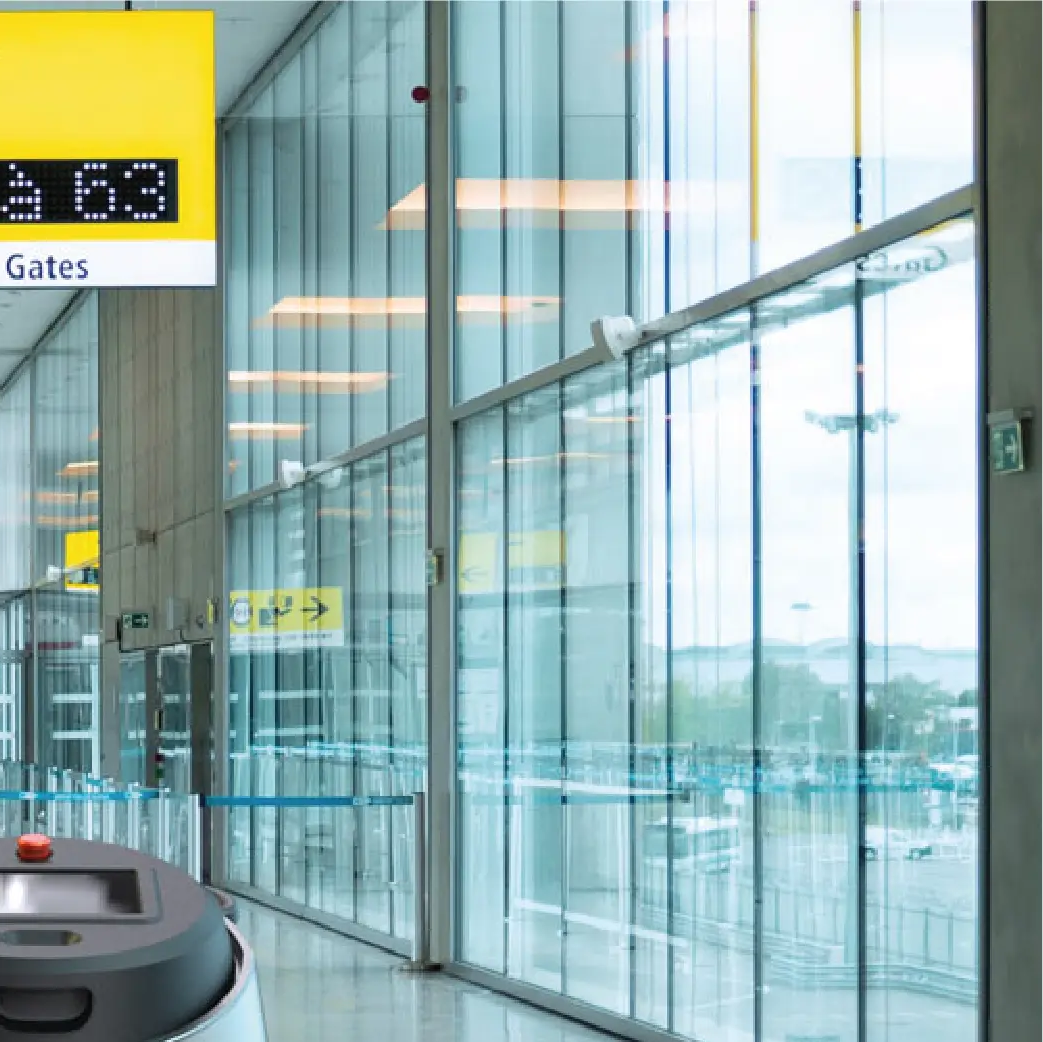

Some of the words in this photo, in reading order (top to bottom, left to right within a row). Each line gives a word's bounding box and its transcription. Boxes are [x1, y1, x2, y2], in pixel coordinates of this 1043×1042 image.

[0, 163, 41, 220] à
[74, 162, 166, 220] 63
[6, 254, 89, 281] Gates
